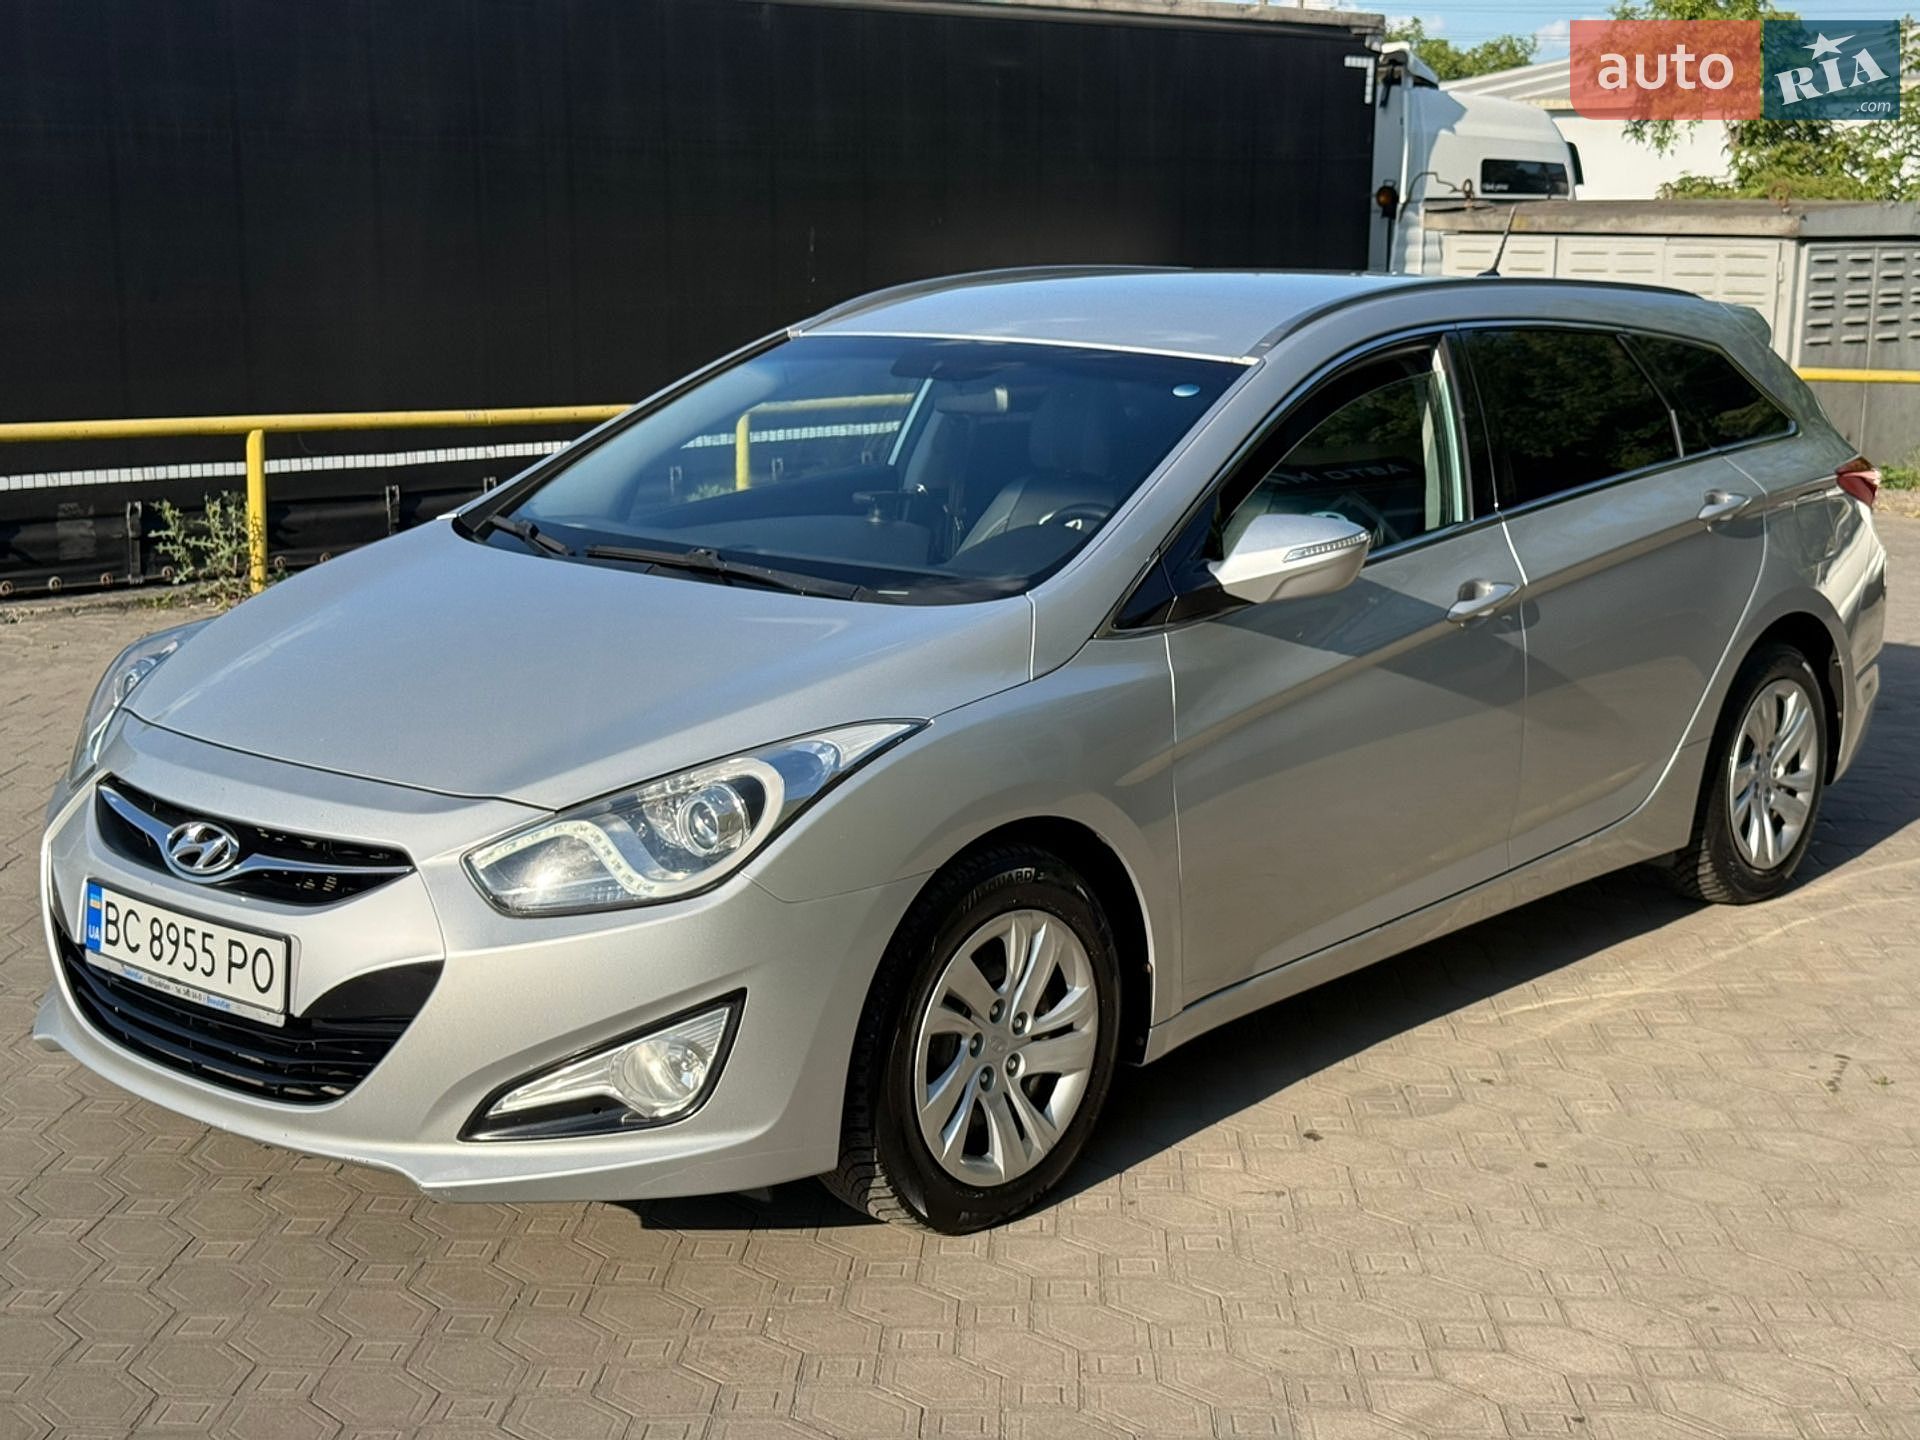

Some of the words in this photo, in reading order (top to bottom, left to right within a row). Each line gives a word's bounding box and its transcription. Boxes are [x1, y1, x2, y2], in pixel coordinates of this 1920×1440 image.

[88, 924, 100, 940] UA
[105, 901, 141, 953] BC
[149, 917, 216, 977] 8955
[227, 938, 275, 994] PO
